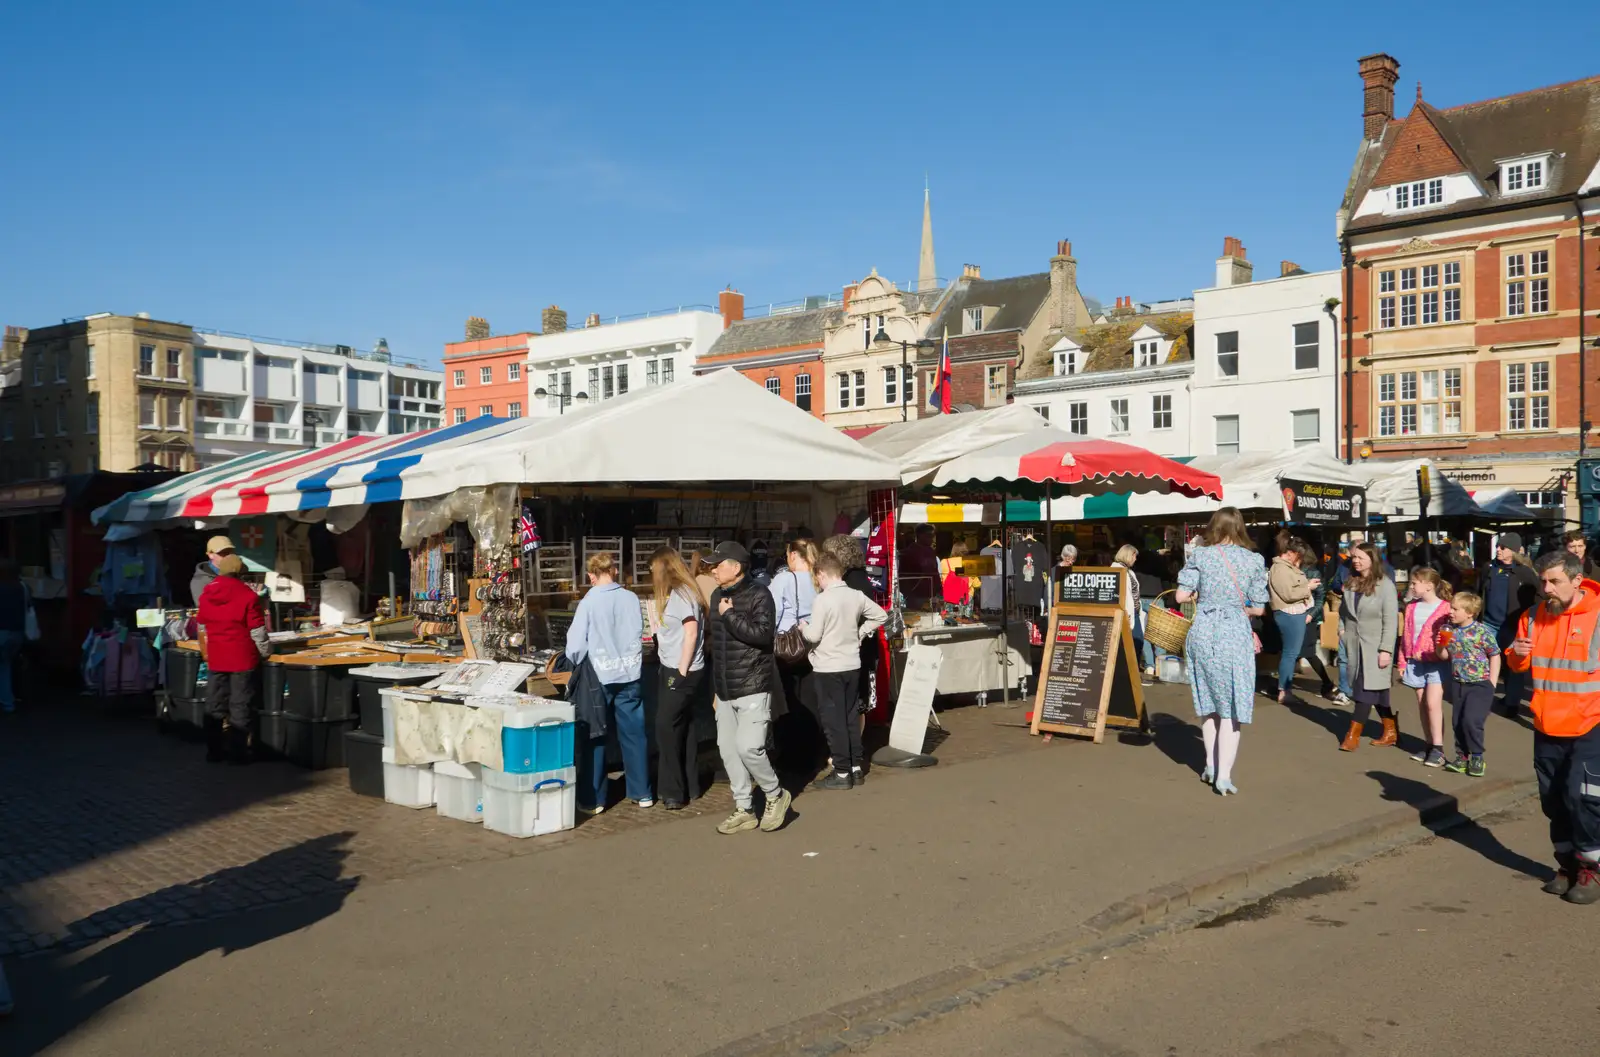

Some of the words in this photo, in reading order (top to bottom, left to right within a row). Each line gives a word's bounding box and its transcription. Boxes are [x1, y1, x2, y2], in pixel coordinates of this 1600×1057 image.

[1303, 484, 1323, 497] Officially
[1323, 487, 1344, 497] Licensed
[1297, 496, 1318, 509] BAND
[1318, 498, 1351, 511] T-SHIRTS
[1064, 573, 1083, 588] ICED
[1085, 574, 1116, 588] COFFEE
